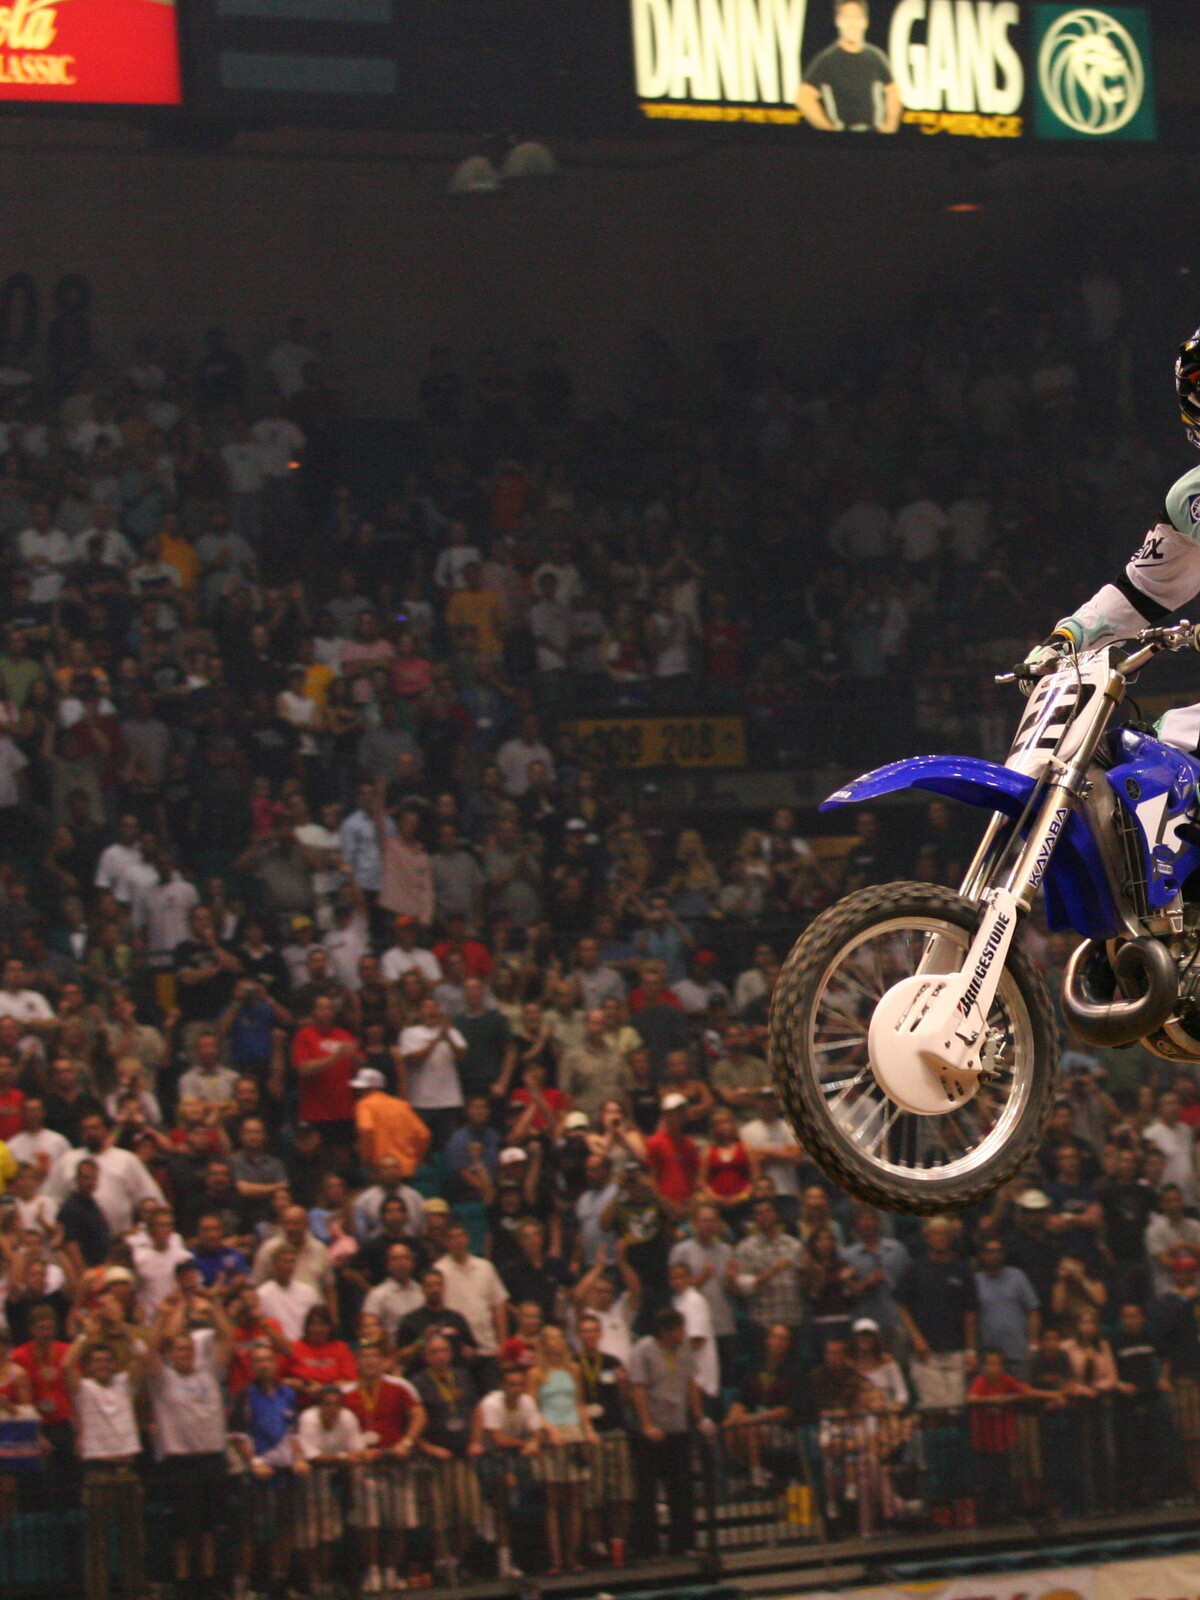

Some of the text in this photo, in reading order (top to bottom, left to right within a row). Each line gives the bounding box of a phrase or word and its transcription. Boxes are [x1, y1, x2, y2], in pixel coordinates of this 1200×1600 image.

[632, 0, 1025, 114] DANNY GANS
[1028, 807, 1068, 887] KAYABA
[957, 912, 1010, 1018] BRIDGESTONE
